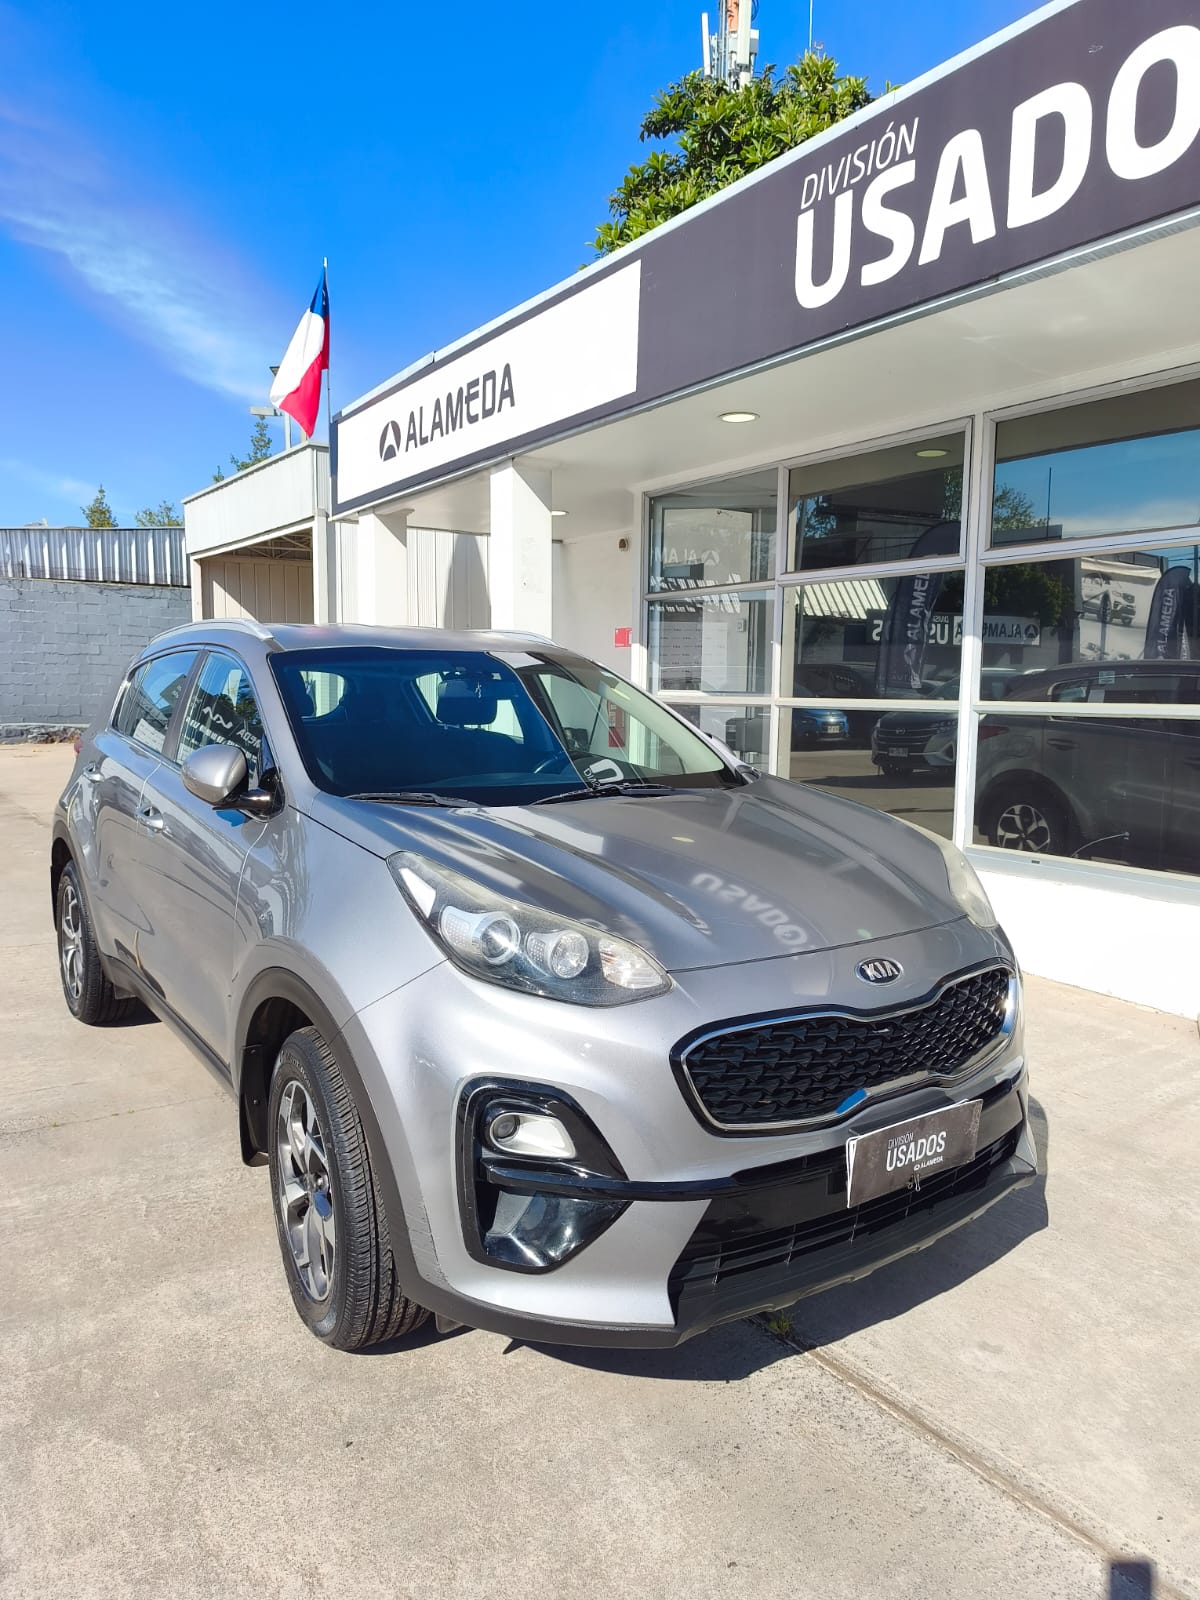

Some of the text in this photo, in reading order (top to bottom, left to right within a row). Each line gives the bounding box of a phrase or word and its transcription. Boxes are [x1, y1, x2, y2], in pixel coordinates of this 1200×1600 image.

[800, 116, 919, 210] DIVISIÓN
[406, 362, 515, 453] ALAMEDA
[861, 960, 900, 981] KIA
[886, 1130, 947, 1172] USADOS
